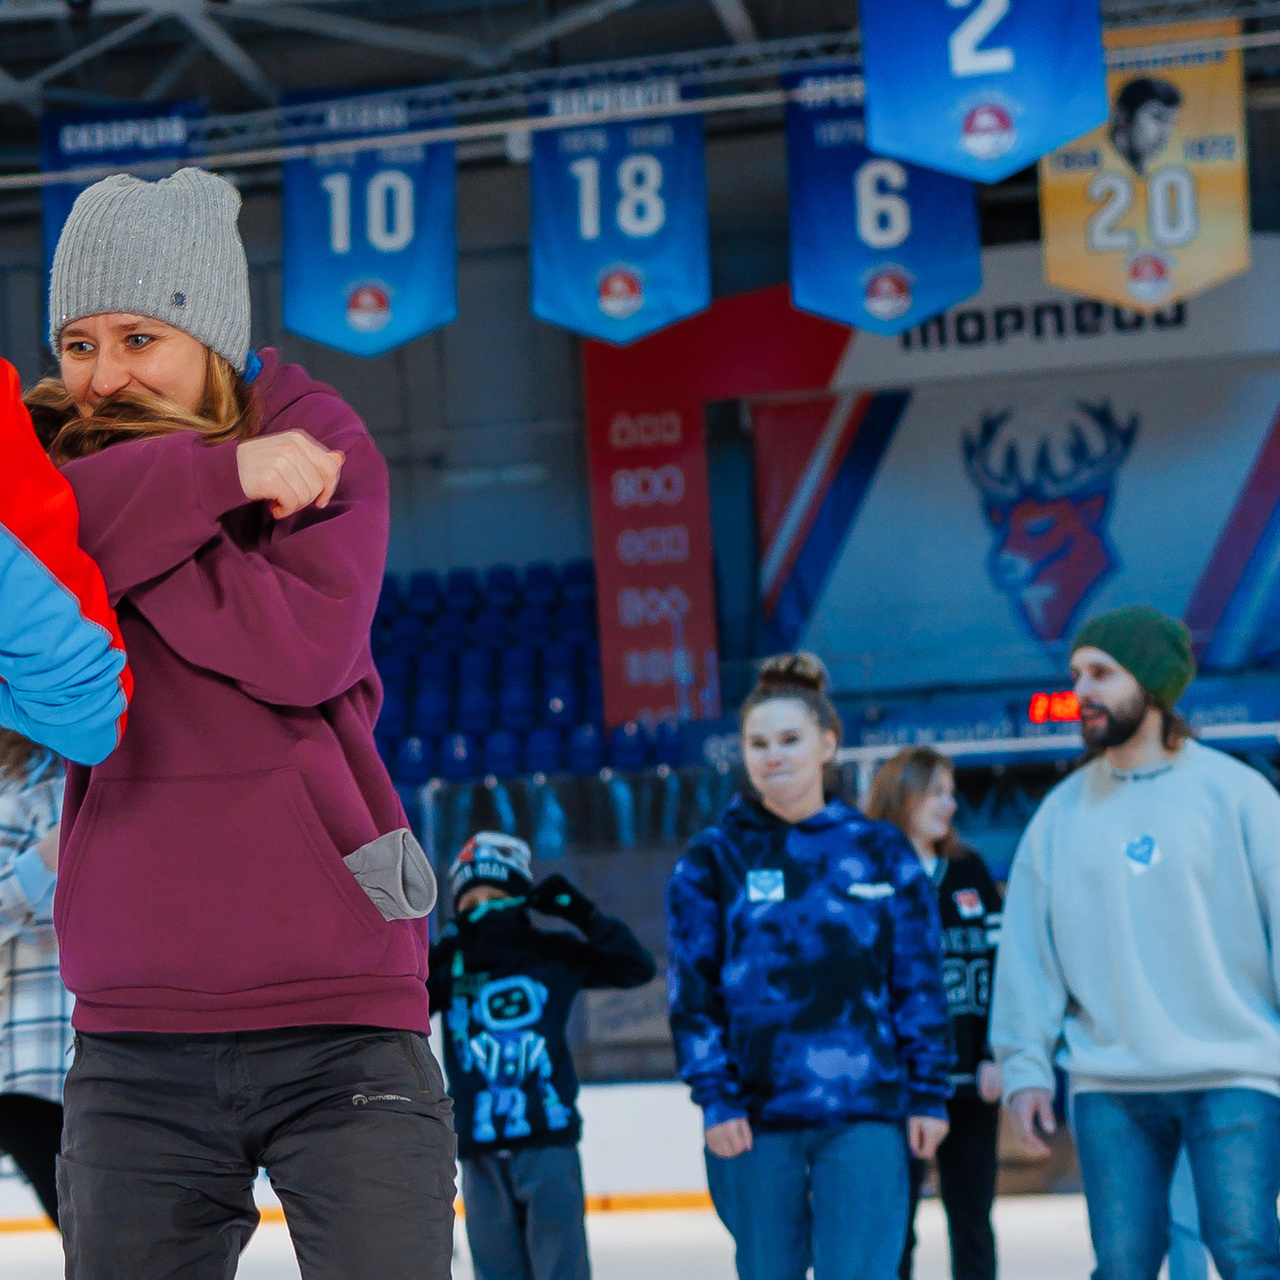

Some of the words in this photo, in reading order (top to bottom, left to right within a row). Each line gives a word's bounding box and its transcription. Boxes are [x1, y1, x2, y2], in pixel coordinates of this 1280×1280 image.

[321, 170, 415, 253] 10
[569, 153, 666, 241] 18
[853, 158, 912, 250] 6
[1087, 165, 1199, 252] 20
